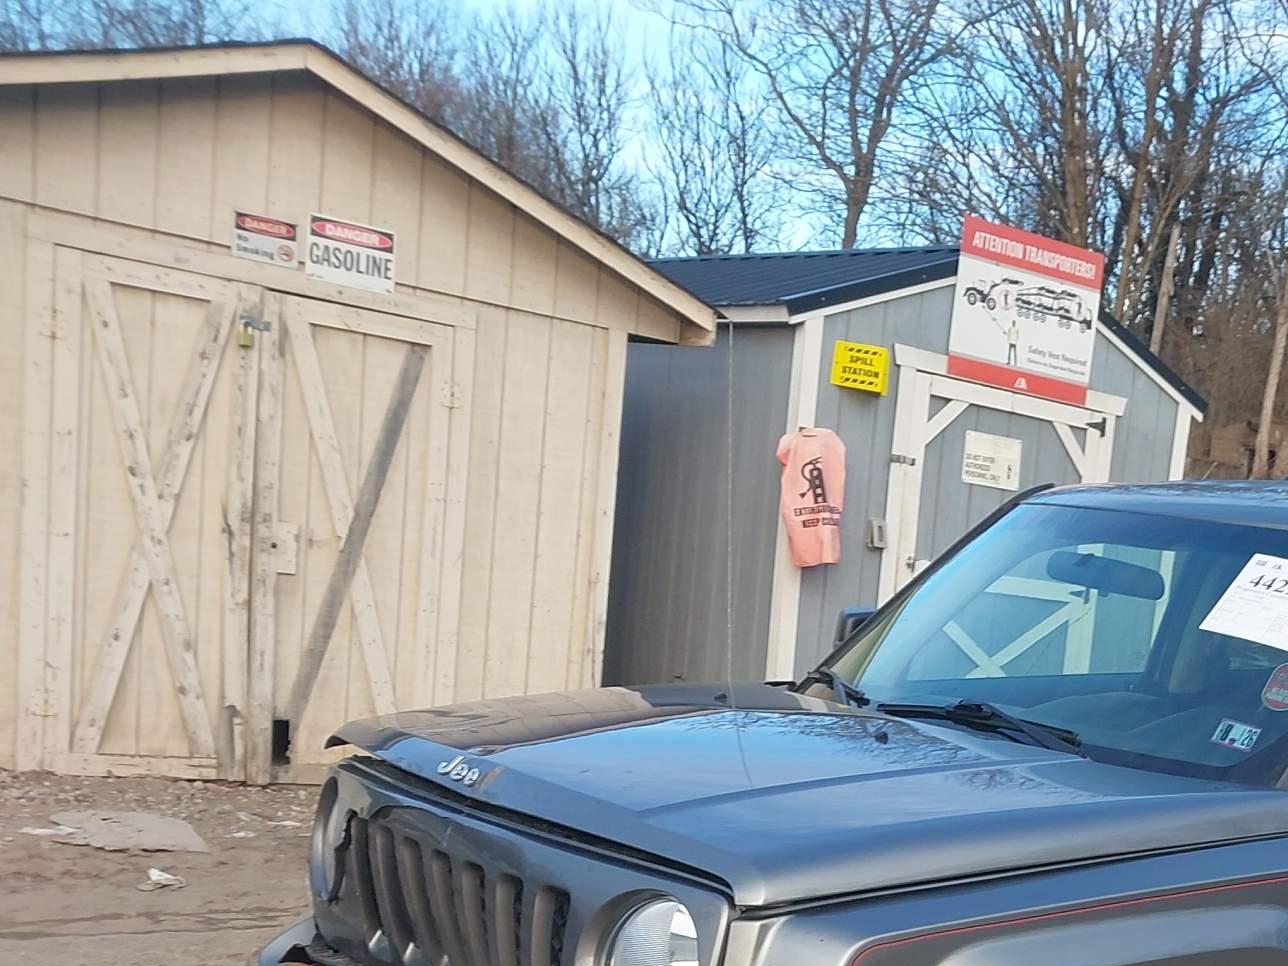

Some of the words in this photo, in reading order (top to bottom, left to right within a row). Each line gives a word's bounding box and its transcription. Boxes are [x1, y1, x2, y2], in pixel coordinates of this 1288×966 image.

[244, 219, 288, 234] DANGER
[325, 223, 380, 244] DANGER
[236, 243, 275, 260] Smoking
[972, 231, 1024, 259] ATTENTION
[310, 242, 393, 280] GASOLINE
[850, 355, 875, 366] SPILL
[842, 365, 880, 379] STATION
